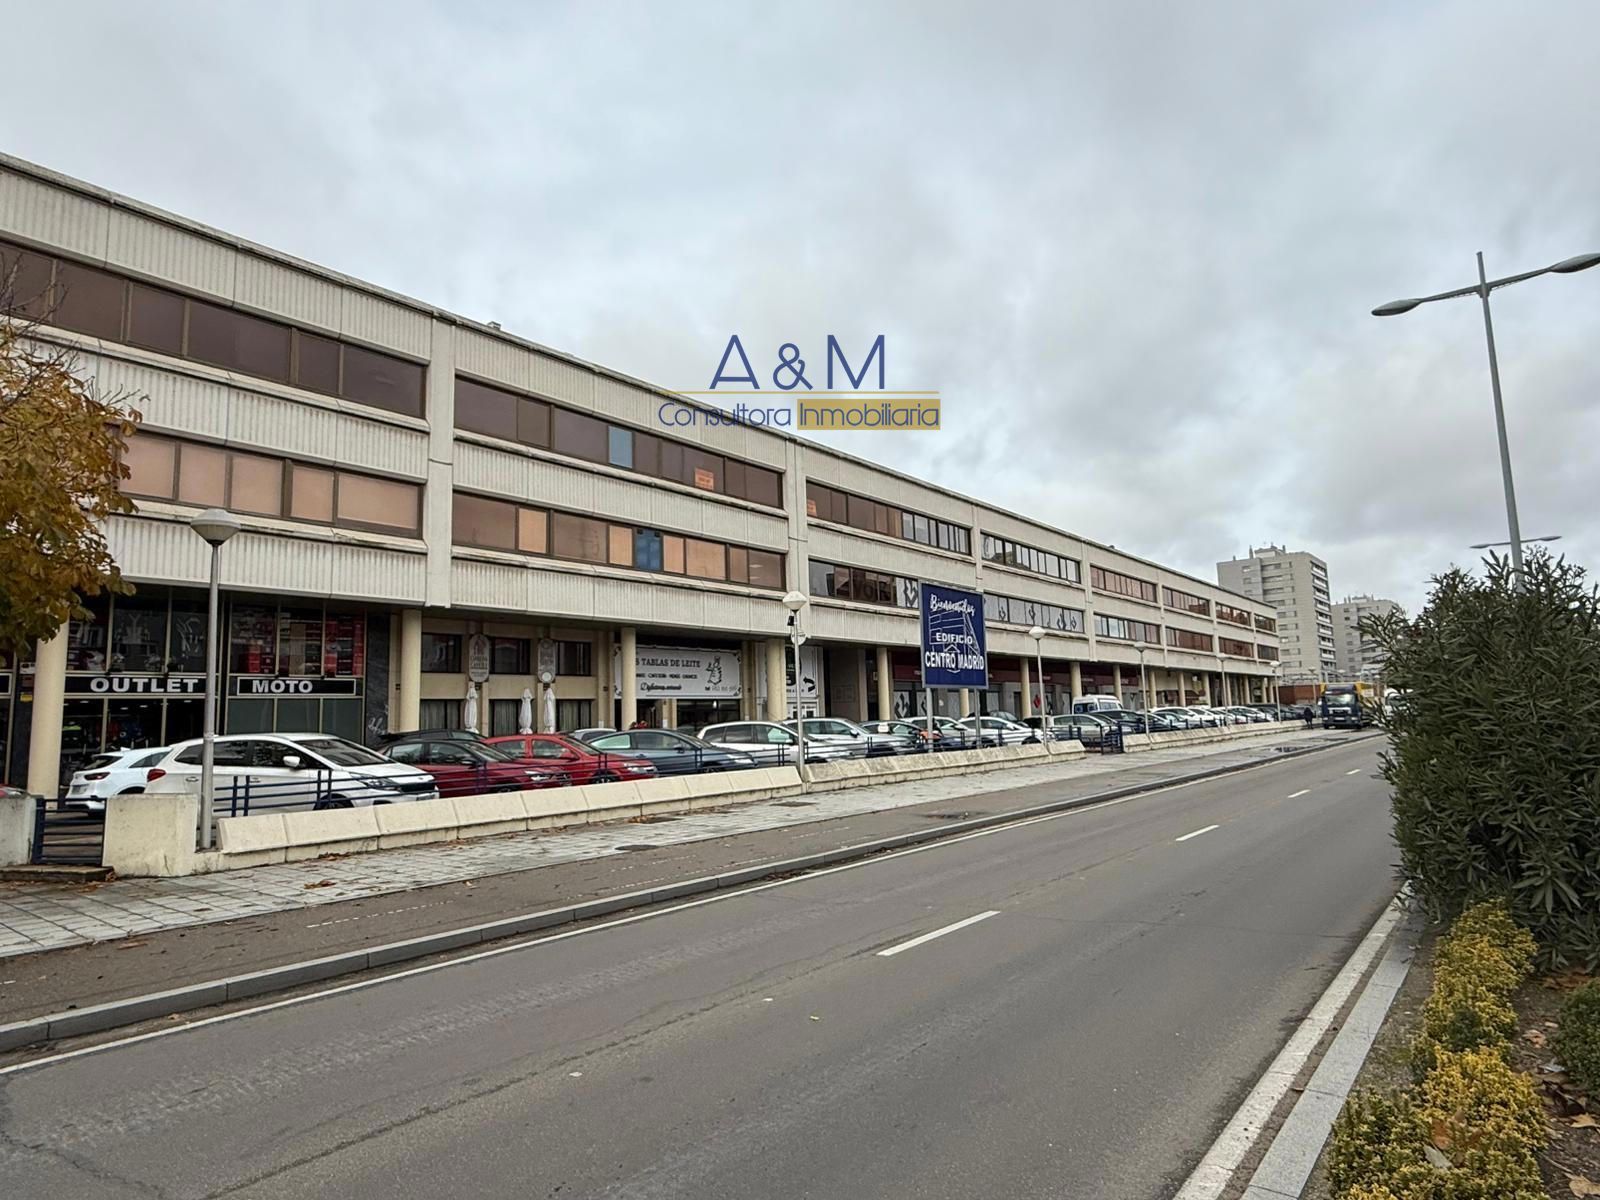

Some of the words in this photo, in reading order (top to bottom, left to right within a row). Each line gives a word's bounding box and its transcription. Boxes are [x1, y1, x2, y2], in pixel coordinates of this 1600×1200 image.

[935, 632, 973, 645] EDIFICIO
[641, 658, 669, 667] TABLAS
[670, 659, 680, 667] DE
[925, 651, 956, 668] CENTRO
[957, 654, 985, 670] MADRID
[90, 677, 199, 693] OUTLET
[252, 679, 313, 693] MOTO
